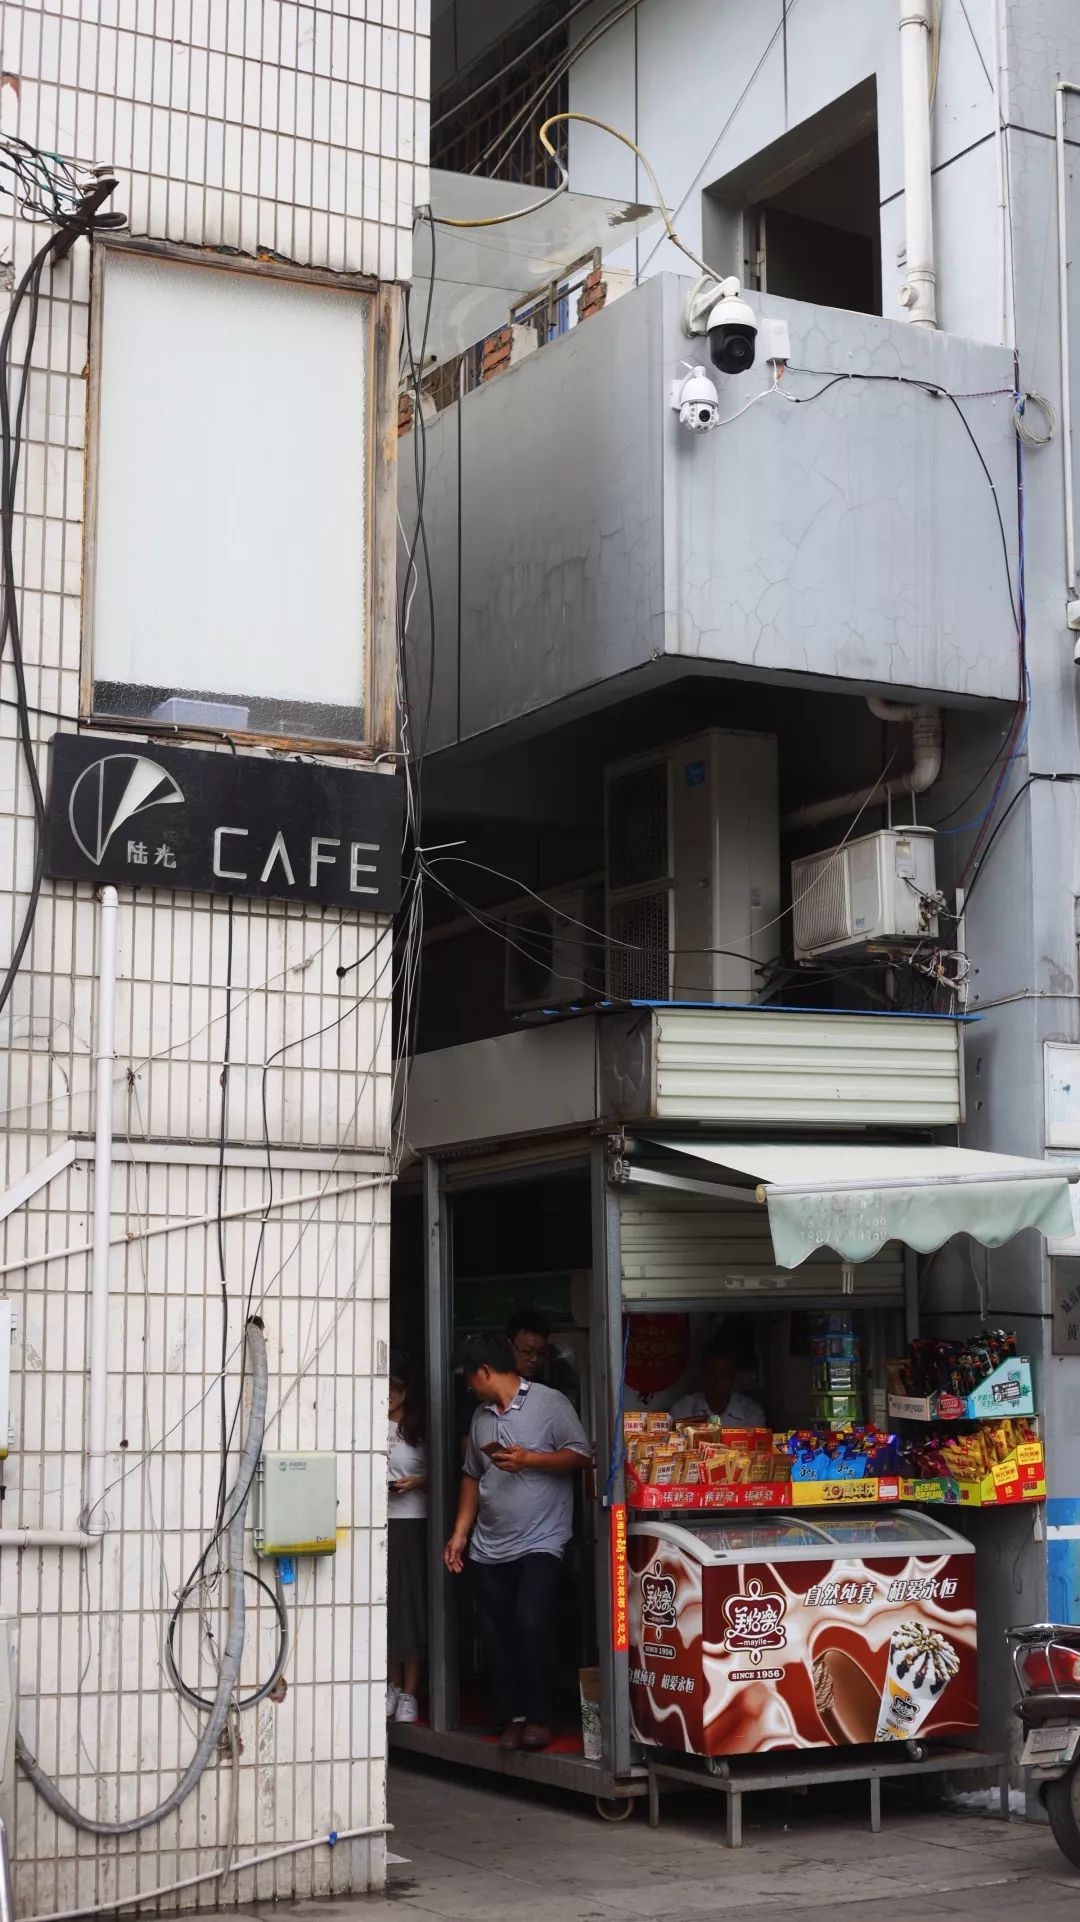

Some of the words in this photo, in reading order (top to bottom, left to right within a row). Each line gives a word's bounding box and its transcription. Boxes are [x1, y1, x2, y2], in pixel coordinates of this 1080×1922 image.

[127, 840, 177, 869] 陆光
[213, 826, 380, 894] CAFE
[803, 1582, 877, 1607] 自然纯真
[887, 1578, 959, 1603] 相爱永恒
[659, 1647, 673, 1657] 1956
[743, 1638, 767, 1647] mayile
[661, 1673, 695, 1693] 相爱永恒
[731, 1672, 755, 1680] SINCE
[757, 1670, 780, 1679] 1956
